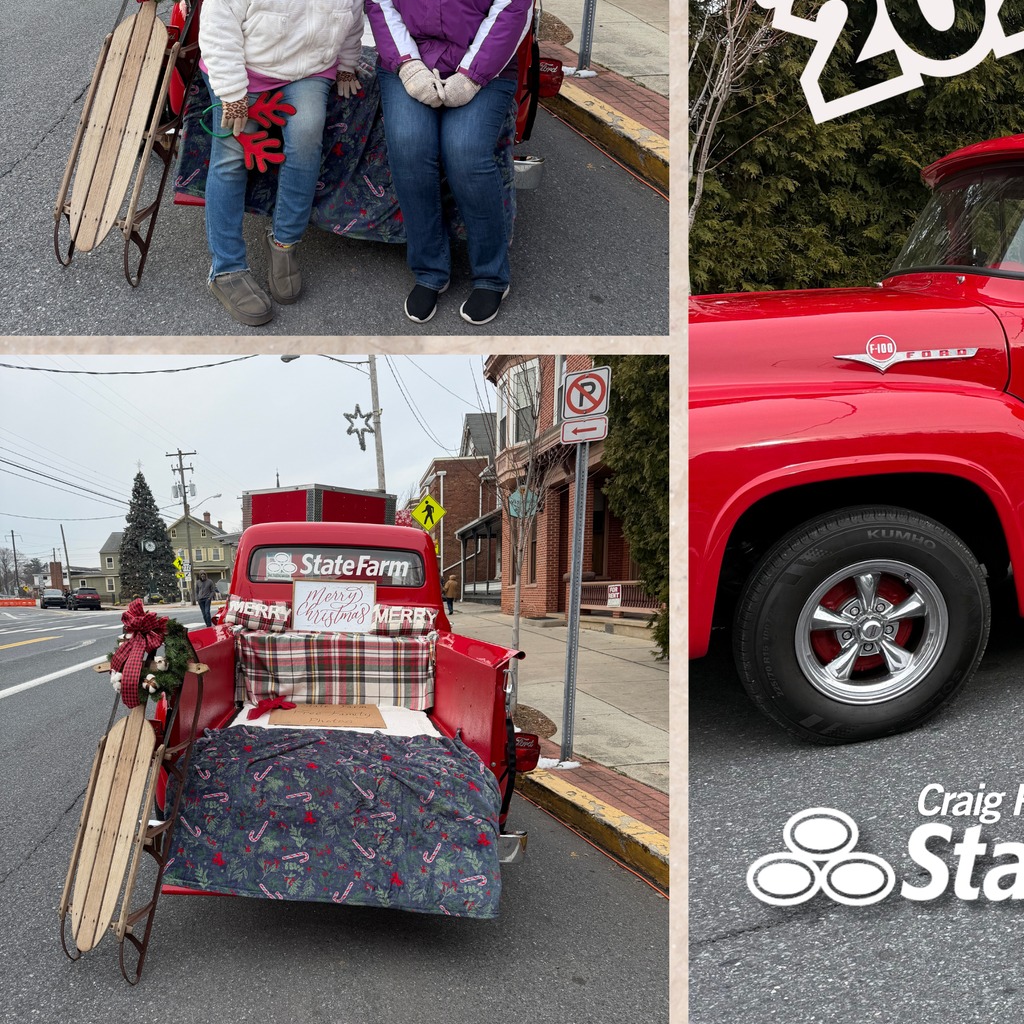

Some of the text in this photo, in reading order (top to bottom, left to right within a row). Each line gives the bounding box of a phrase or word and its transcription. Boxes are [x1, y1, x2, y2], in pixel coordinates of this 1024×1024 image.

[869, 342, 893, 355] F-100
[906, 349, 967, 359] FORD
[867, 529, 937, 550] KUMHO
[306, 586, 364, 607] Merry
[228, 600, 292, 622] MERRY
[296, 600, 371, 627] Christmas
[375, 607, 438, 625] MERRY
